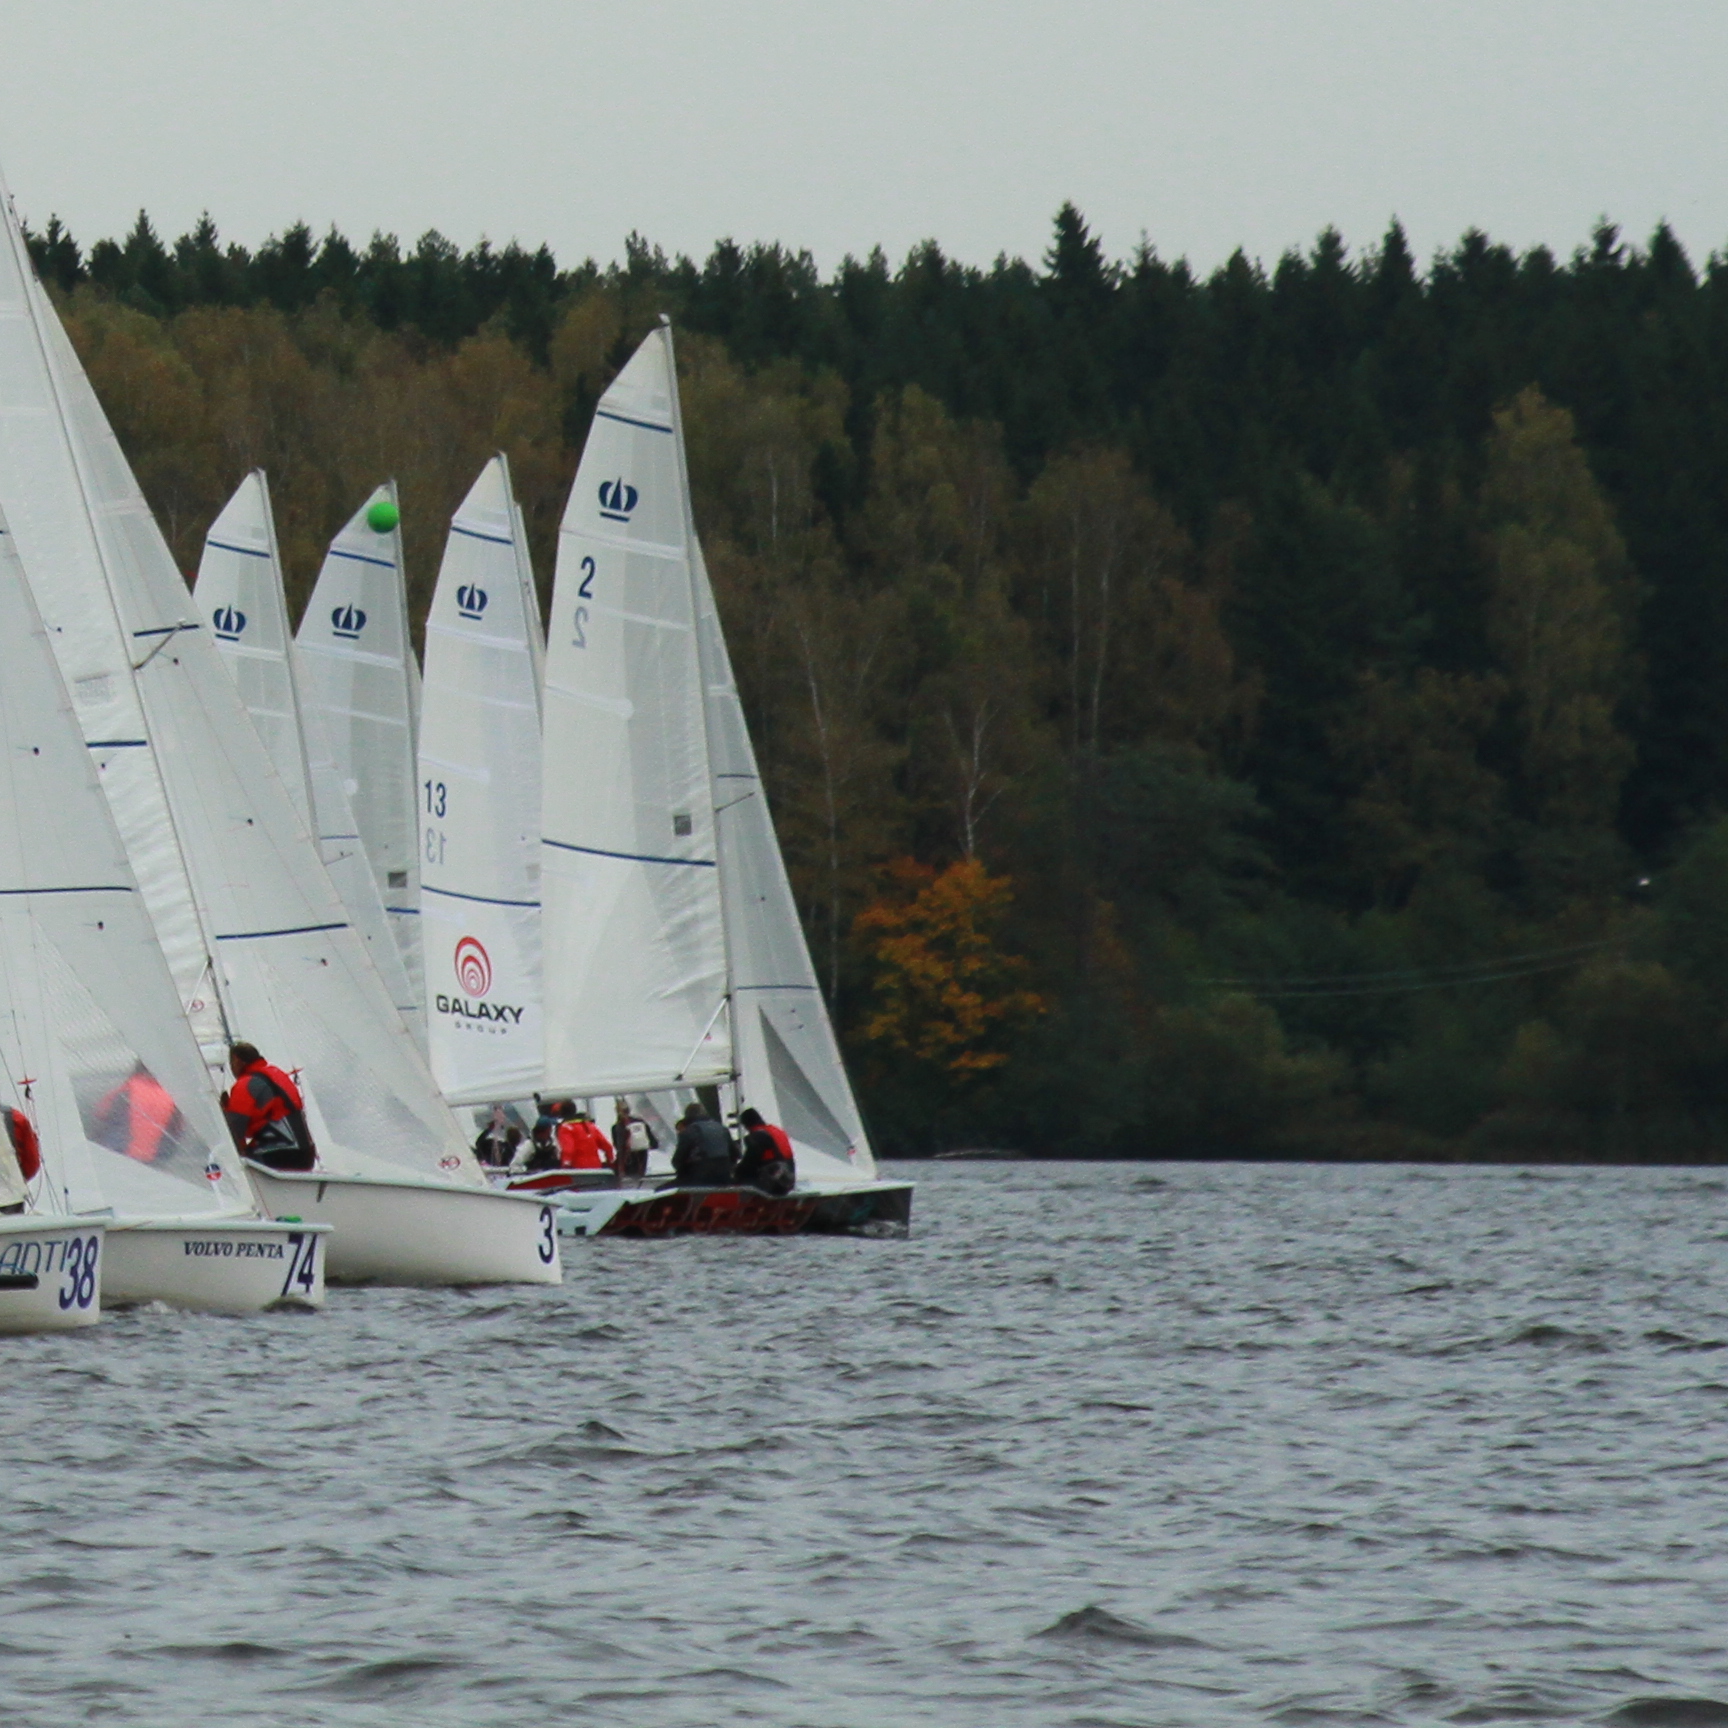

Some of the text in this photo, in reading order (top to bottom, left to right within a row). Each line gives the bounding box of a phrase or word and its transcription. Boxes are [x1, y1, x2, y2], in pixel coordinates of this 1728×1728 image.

[578, 555, 597, 600] 2
[424, 779, 447, 819] 13
[435, 994, 525, 1025] GALAXY
[538, 1205, 554, 1265] 3
[58, 1235, 99, 1311] 38
[183, 1233, 319, 1297] VOLVO PENTA 74
